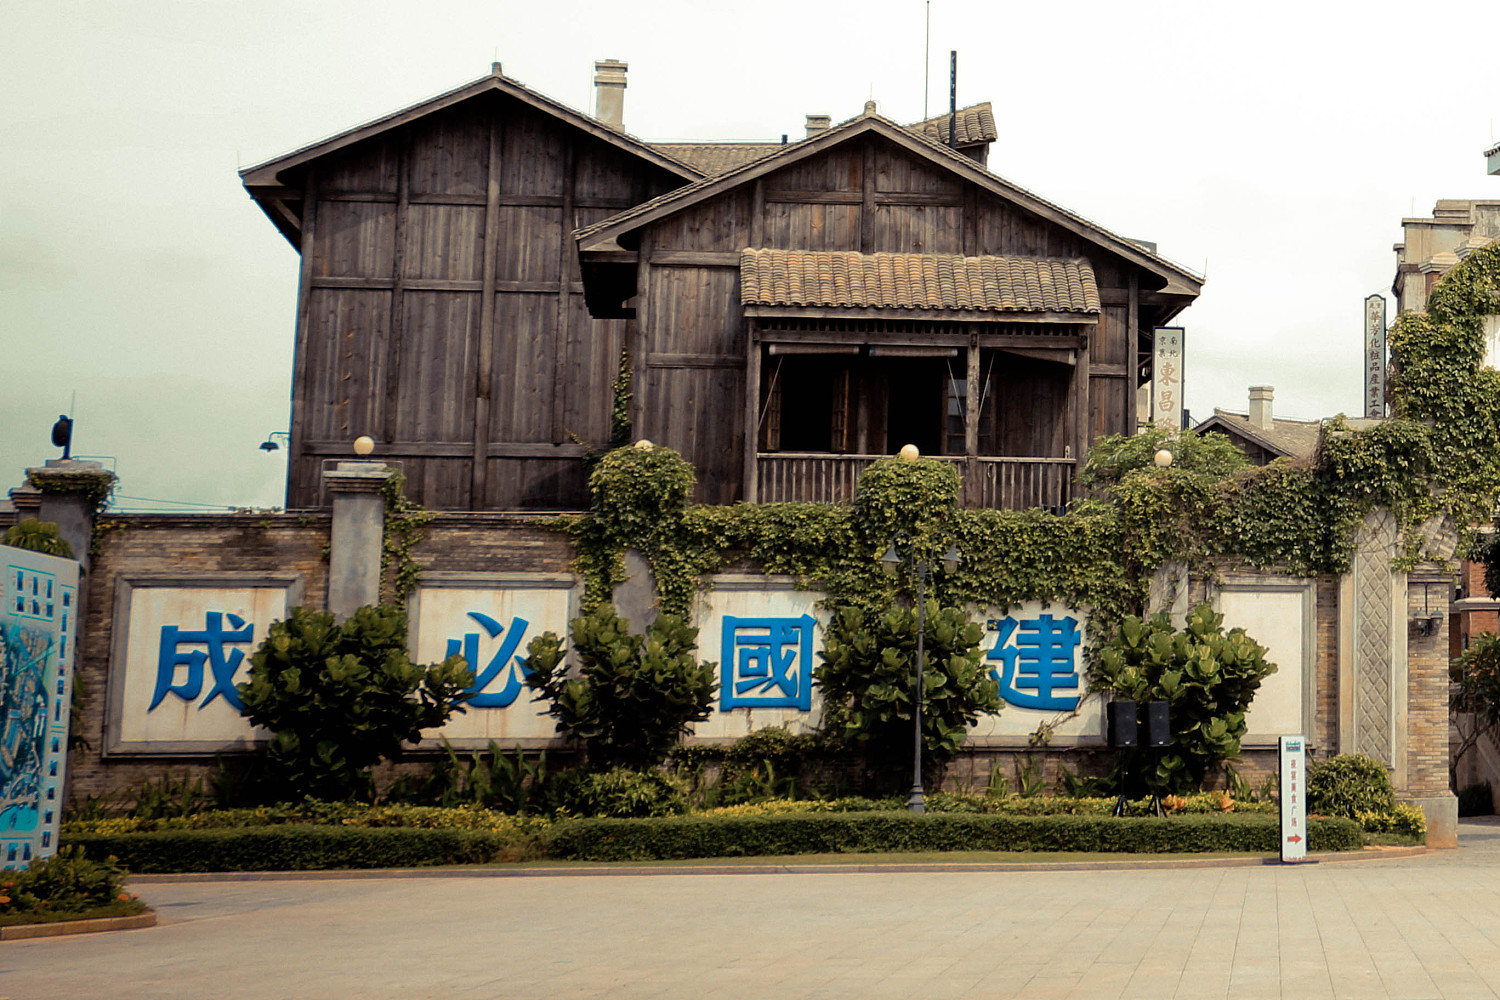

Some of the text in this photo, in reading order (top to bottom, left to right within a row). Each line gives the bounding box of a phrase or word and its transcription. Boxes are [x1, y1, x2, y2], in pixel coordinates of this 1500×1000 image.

[147, 611, 1081, 714] 建 國 必 成
